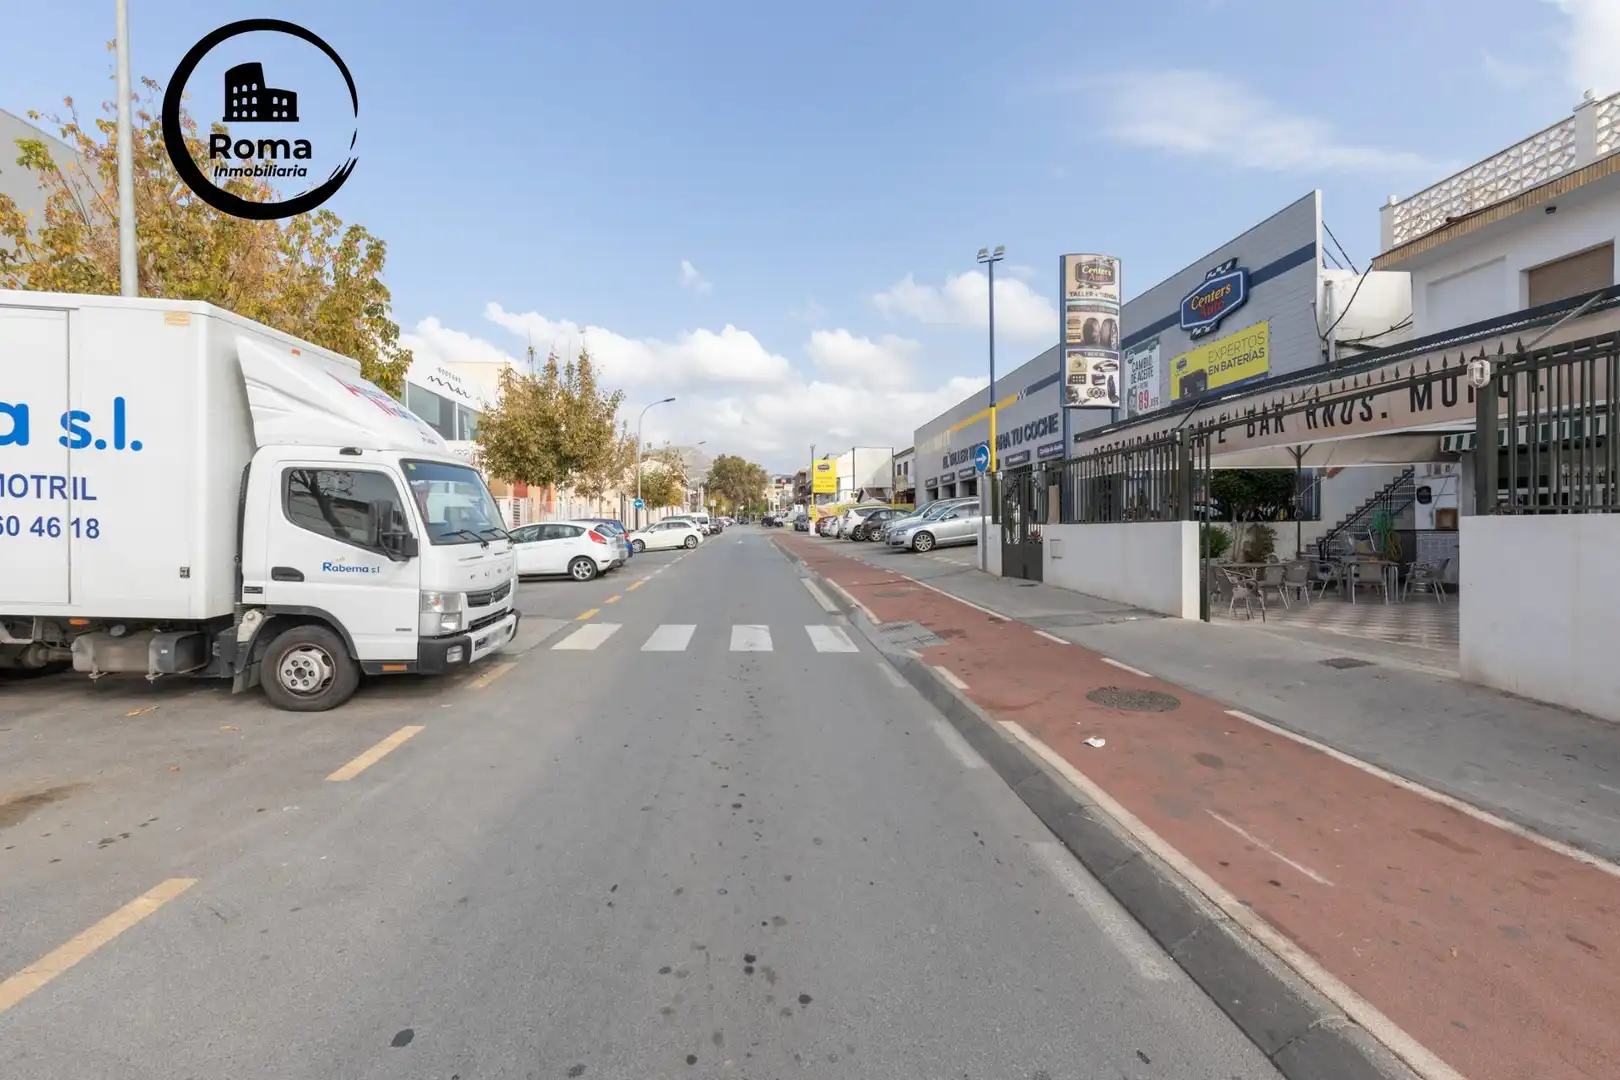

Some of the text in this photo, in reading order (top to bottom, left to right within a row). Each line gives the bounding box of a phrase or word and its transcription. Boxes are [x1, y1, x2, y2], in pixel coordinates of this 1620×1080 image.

[1207, 331, 1266, 364] EXPERTOS
[1208, 363, 1220, 376] EN
[1220, 347, 1265, 372] BATERÍAS
[1131, 354, 1152, 373] CAMBIO
[58, 396, 143, 451] s.l.
[1011, 426, 1023, 446] TU
[1024, 412, 1059, 442] COCHE
[1247, 403, 1285, 438] BAR
[29, 516, 61, 538] 46
[70, 517, 100, 539] 18
[322, 561, 369, 573] Rabema
